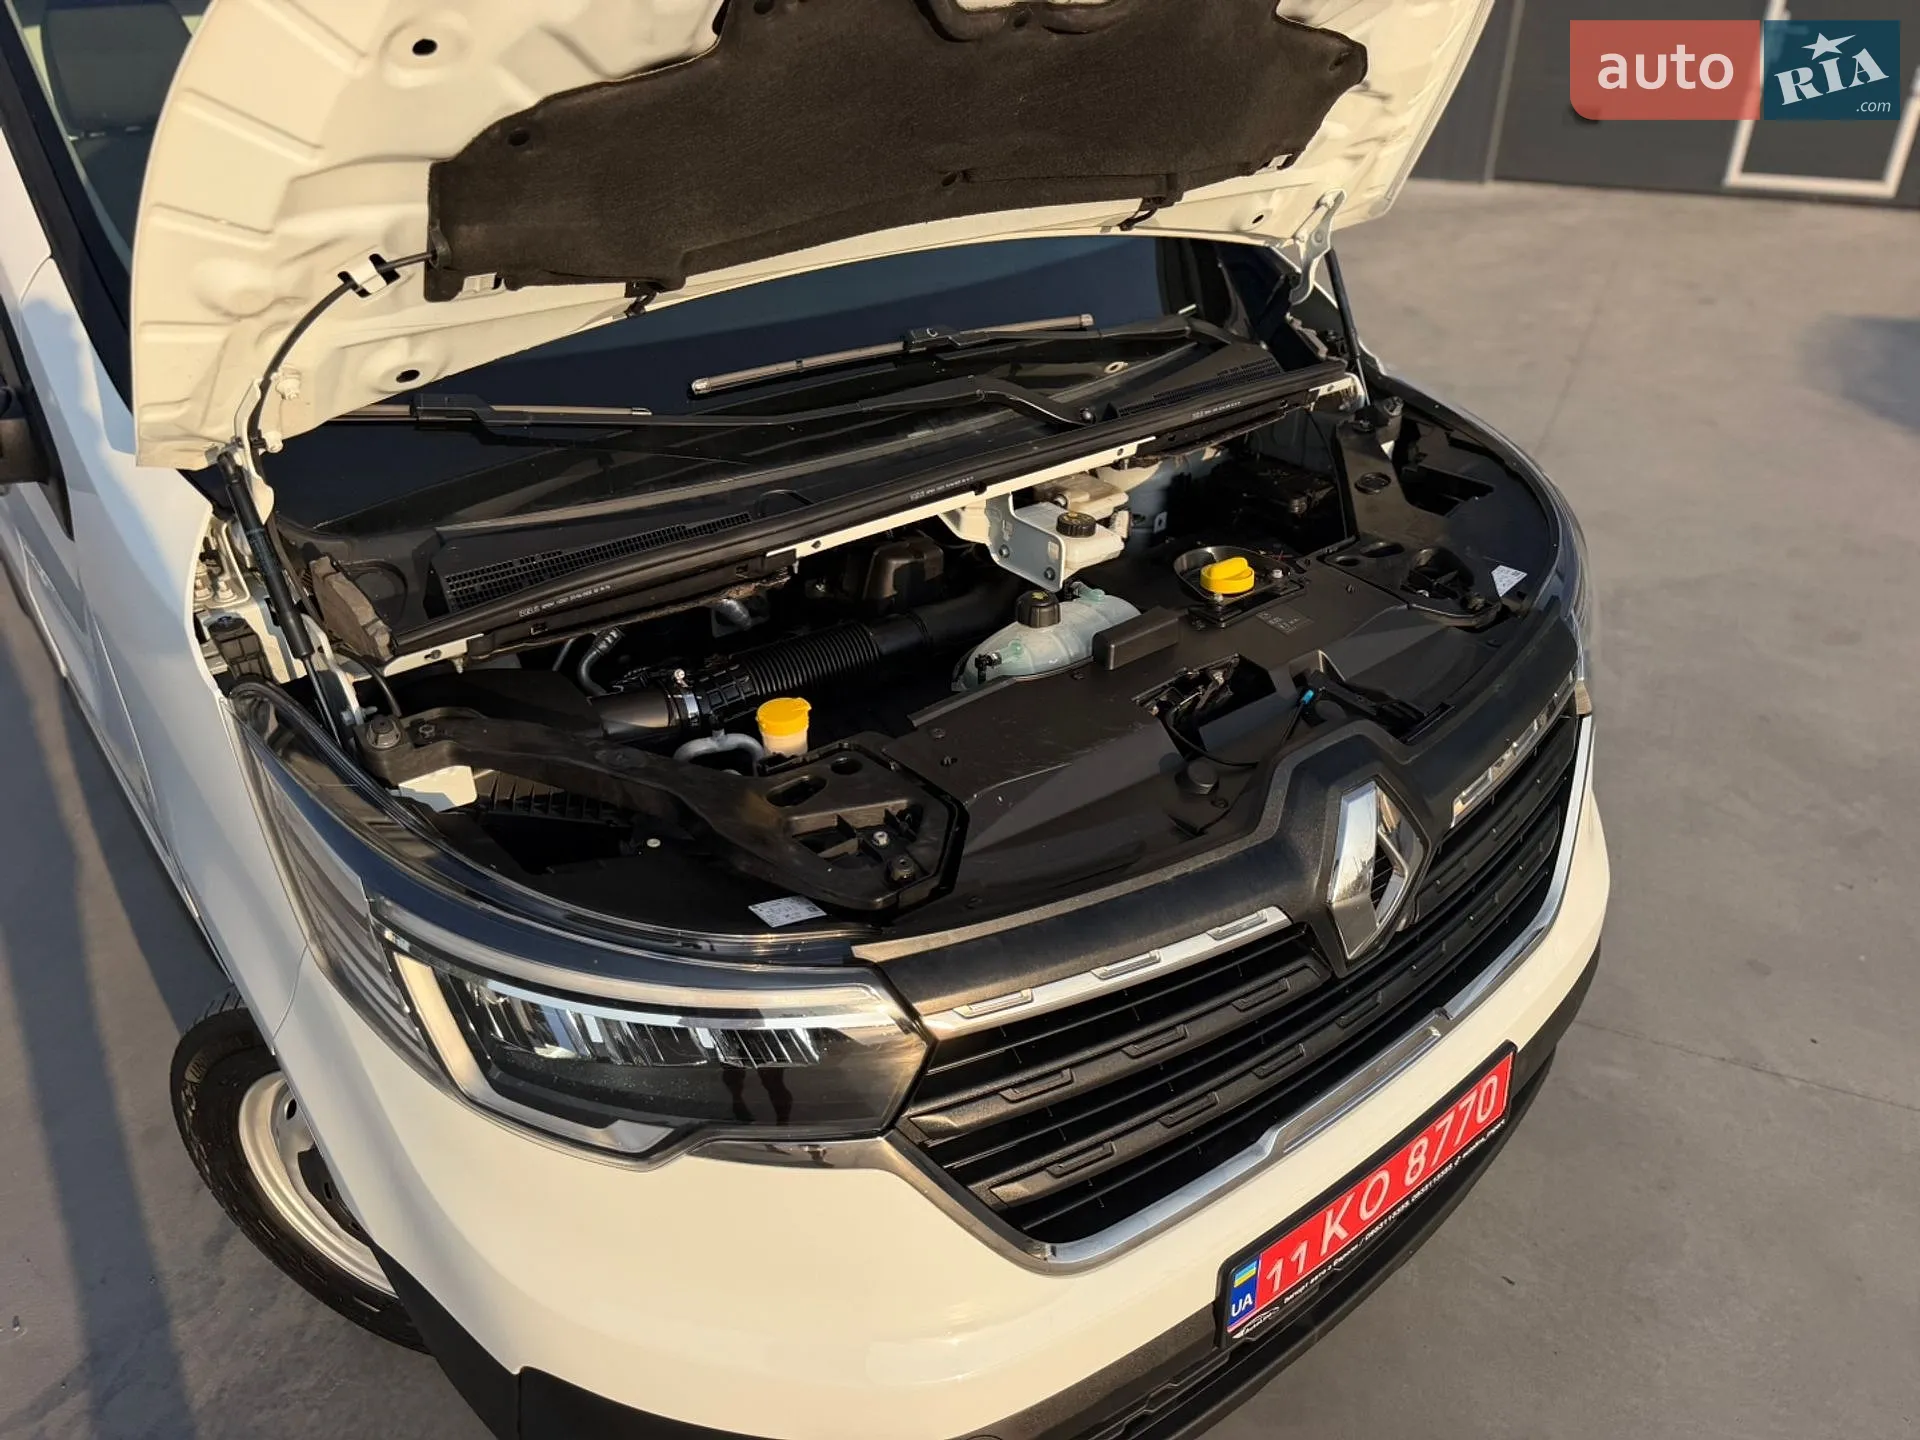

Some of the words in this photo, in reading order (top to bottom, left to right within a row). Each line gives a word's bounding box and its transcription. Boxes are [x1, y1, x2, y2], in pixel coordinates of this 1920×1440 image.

[1266, 1240, 1308, 1292] 11
[1319, 1169, 1390, 1256] KO
[1404, 1074, 1498, 1187] 8770
[1231, 1293, 1253, 1317] UA
